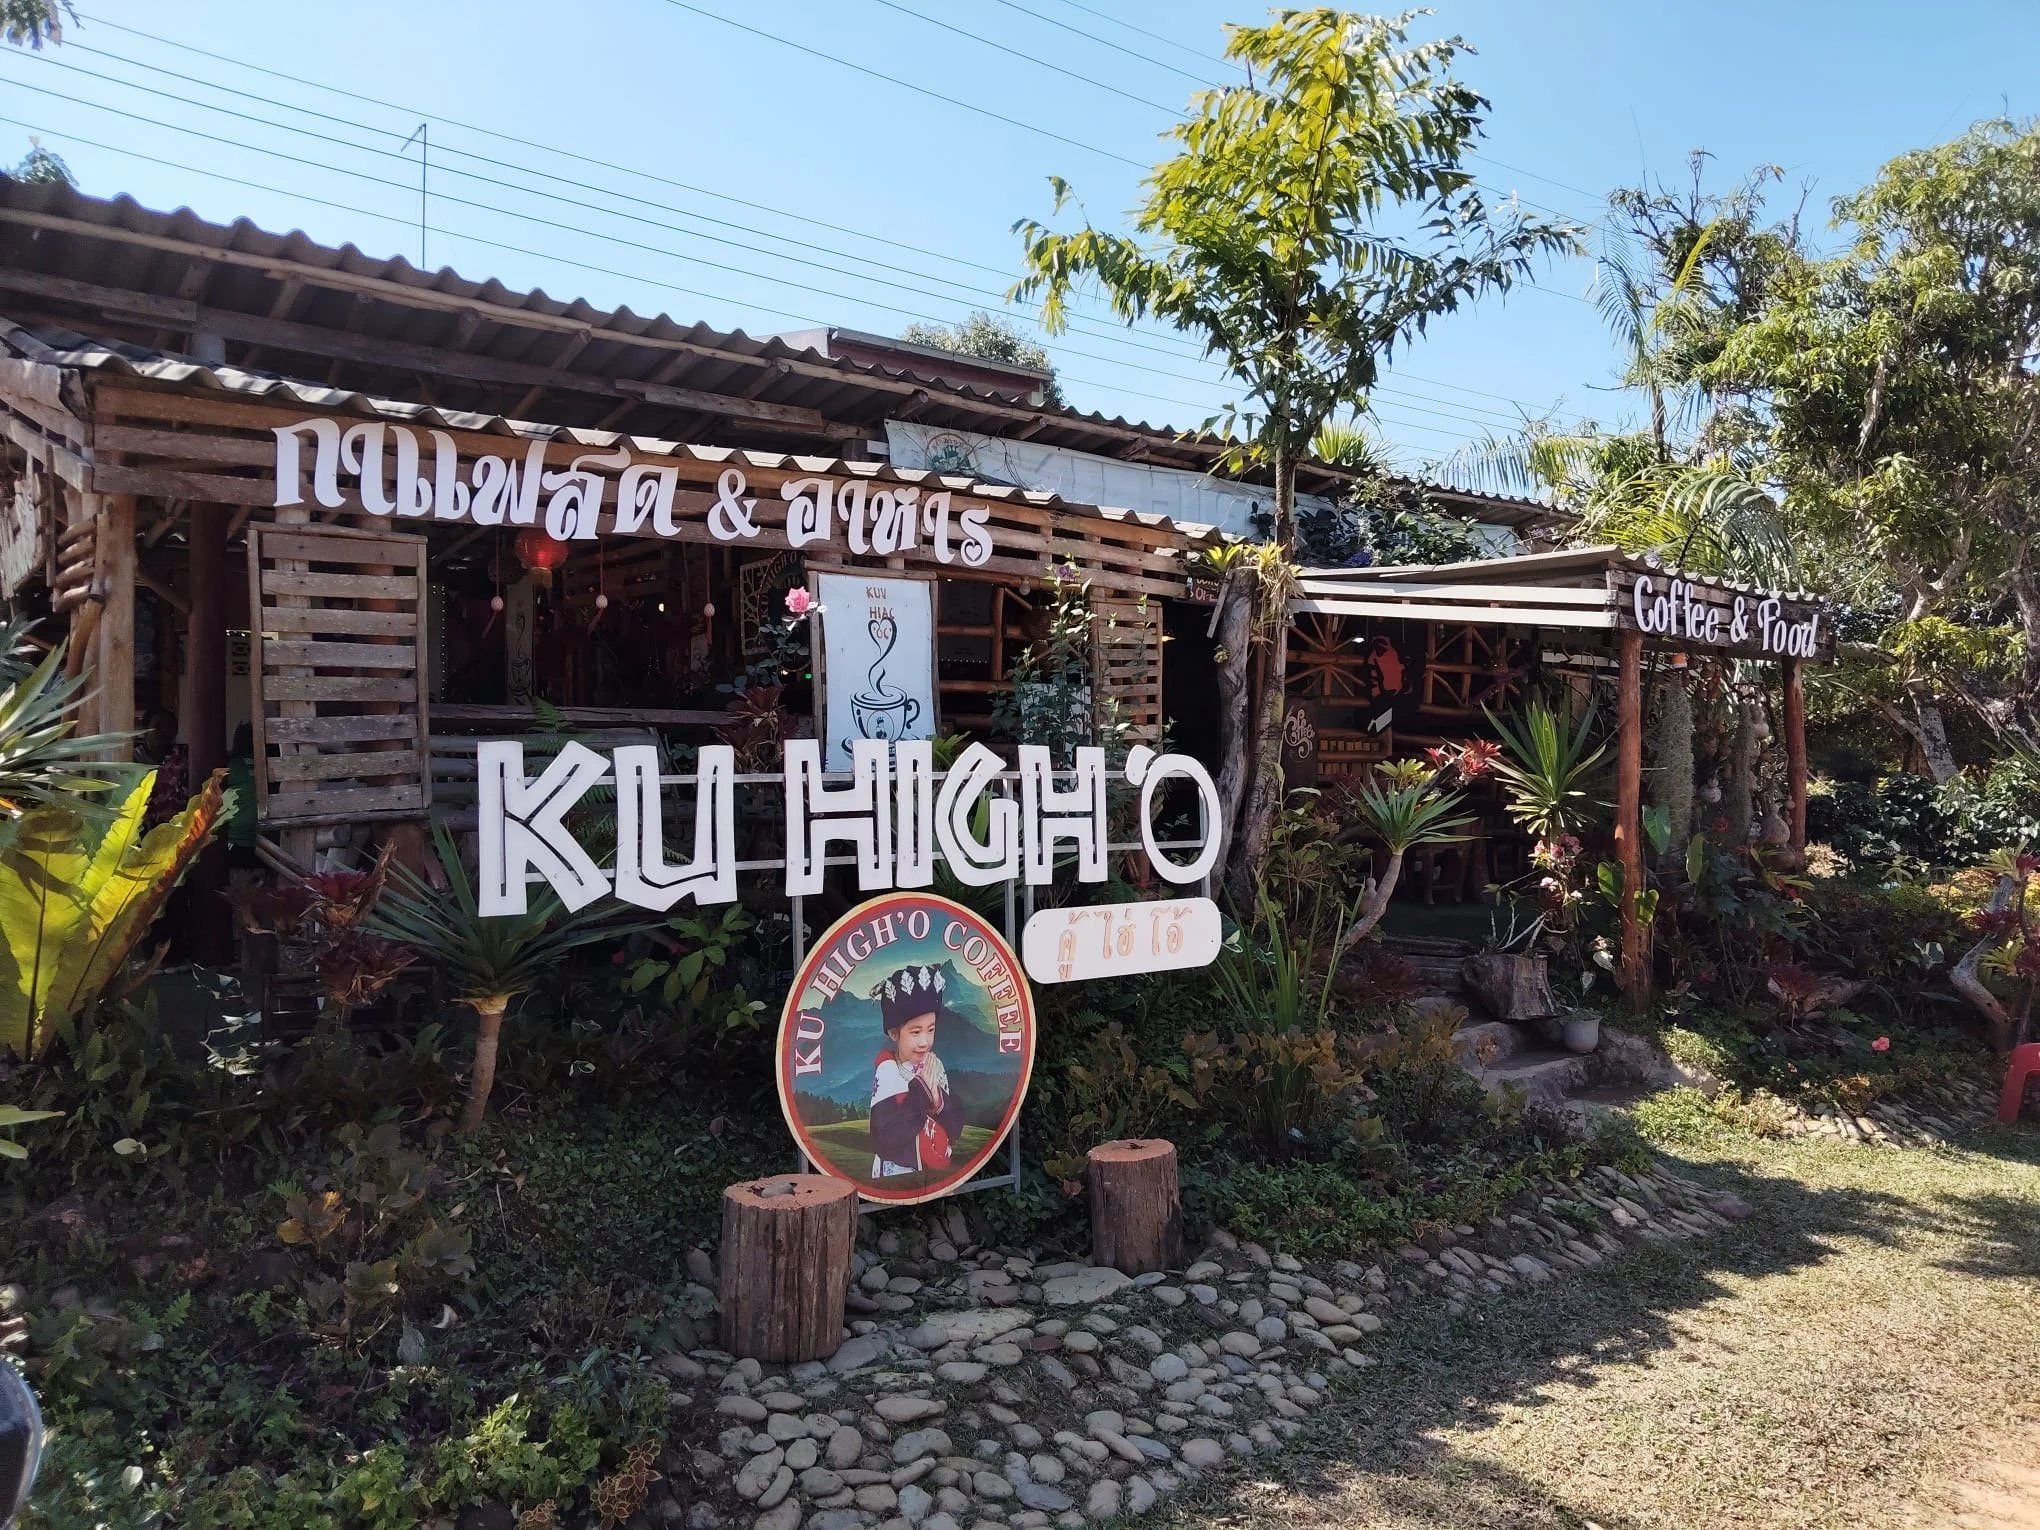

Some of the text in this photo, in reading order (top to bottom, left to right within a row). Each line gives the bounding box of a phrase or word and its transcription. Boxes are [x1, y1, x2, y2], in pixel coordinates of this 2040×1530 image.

[270, 417, 993, 567] กาแฟสด & อาหาร
[1633, 575, 1819, 658] Coffee & Food
[478, 738, 1224, 917] KU HIGH'O
[794, 910, 1022, 1078] KU HIGH'O COFFEE
